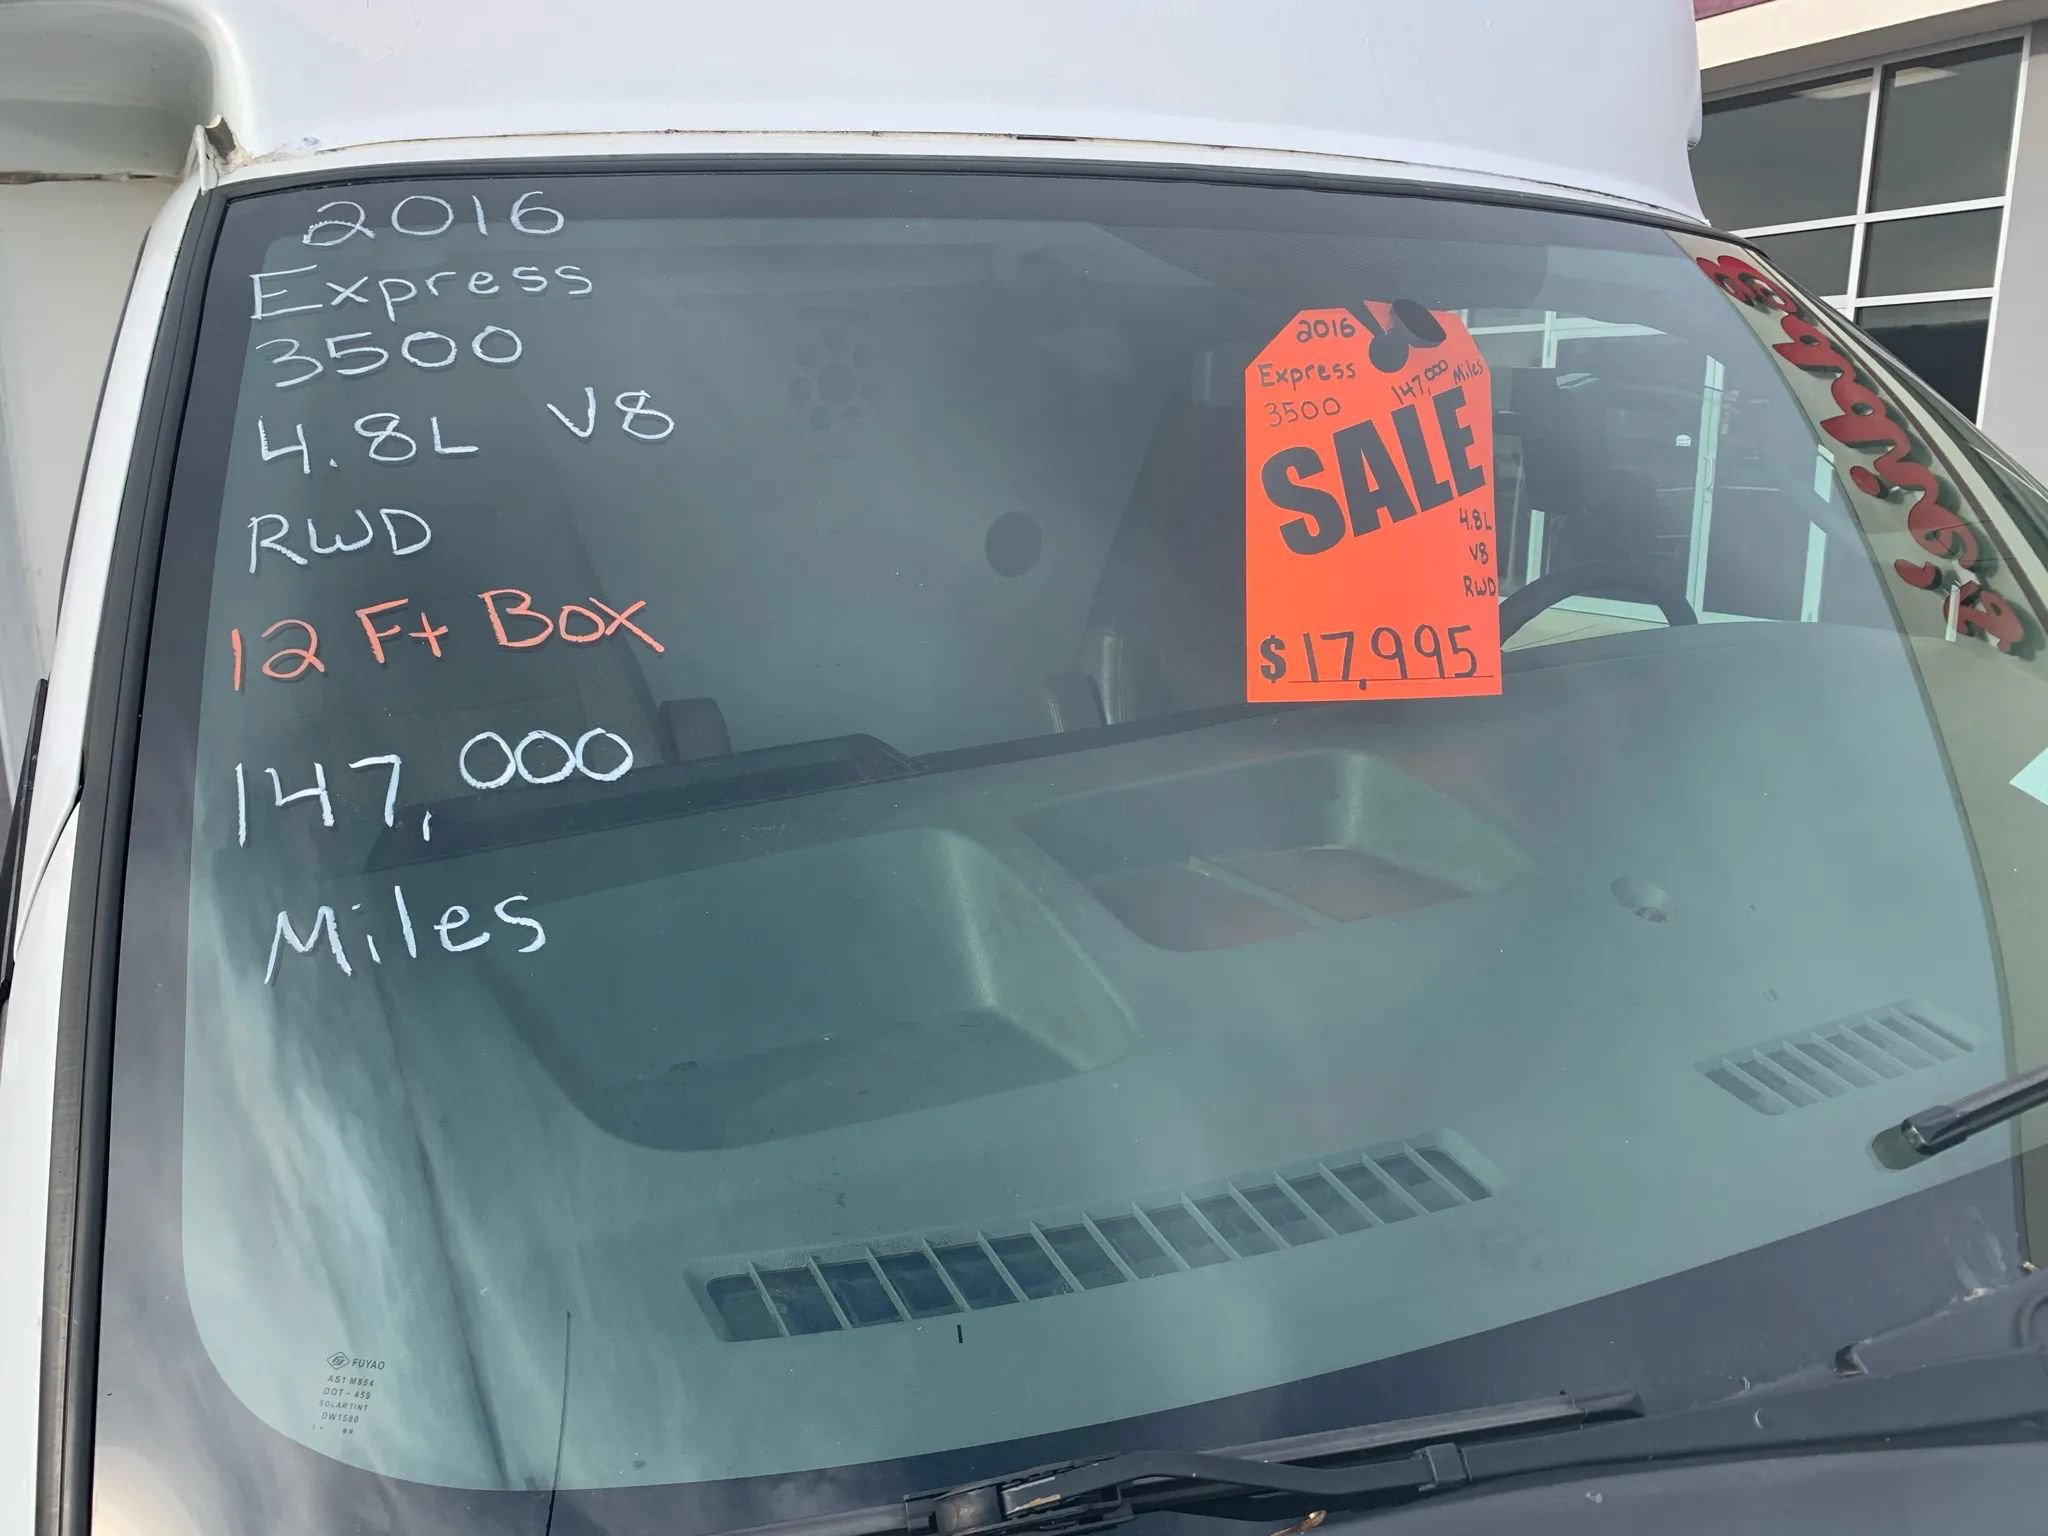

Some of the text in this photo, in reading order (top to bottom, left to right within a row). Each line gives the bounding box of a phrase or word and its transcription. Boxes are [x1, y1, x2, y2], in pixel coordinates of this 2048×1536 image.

[302, 191, 565, 246] 2016
[249, 264, 593, 322] Express
[1295, 317, 1356, 344] 2016
[255, 326, 523, 388] 3500
[1259, 362, 1357, 390] Express
[1453, 359, 1484, 386] Miles
[257, 387, 675, 474] 4.8L V8
[1264, 396, 1343, 427] 3500
[1261, 386, 1487, 556] SALE
[248, 508, 432, 574] RWD
[1459, 508, 1492, 532] 4.8L
[1468, 542, 1489, 565] V8
[1463, 575, 1498, 598] RWD
[231, 618, 326, 691] 12
[355, 597, 449, 664] Ft
[264, 885, 546, 985] Miles
[352, 1358, 386, 1370] FUYAO
